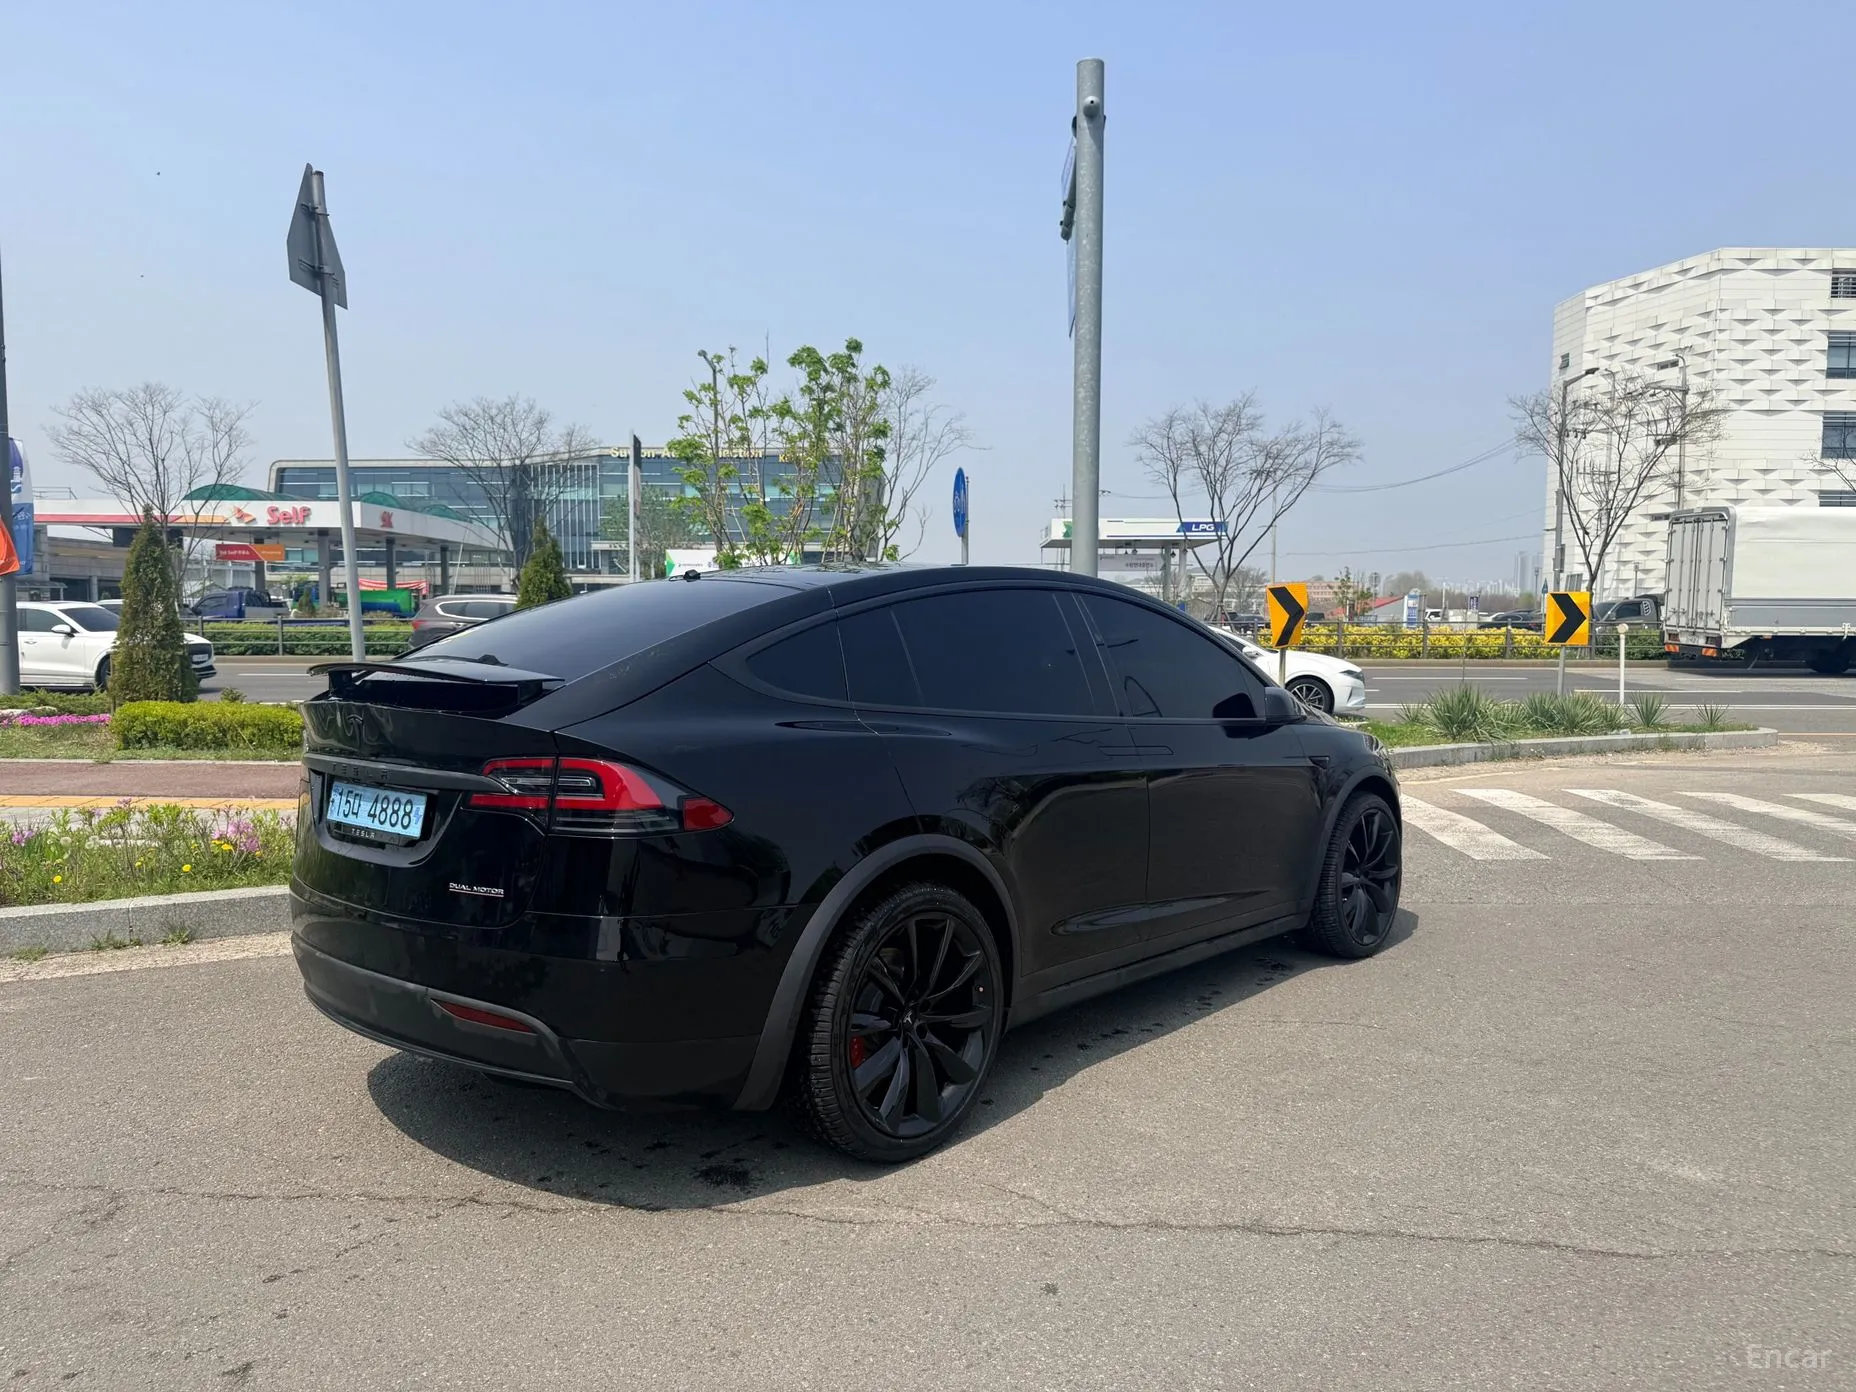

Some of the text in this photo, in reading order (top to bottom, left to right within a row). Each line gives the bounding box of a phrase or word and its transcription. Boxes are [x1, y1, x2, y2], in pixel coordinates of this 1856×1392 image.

[266, 505, 311, 525] Self
[1191, 523, 1215, 532] LPG
[337, 787, 413, 830] 15다 4888
[351, 828, 375, 839] TESLA
[449, 882, 504, 895] DUAL MOTOR
